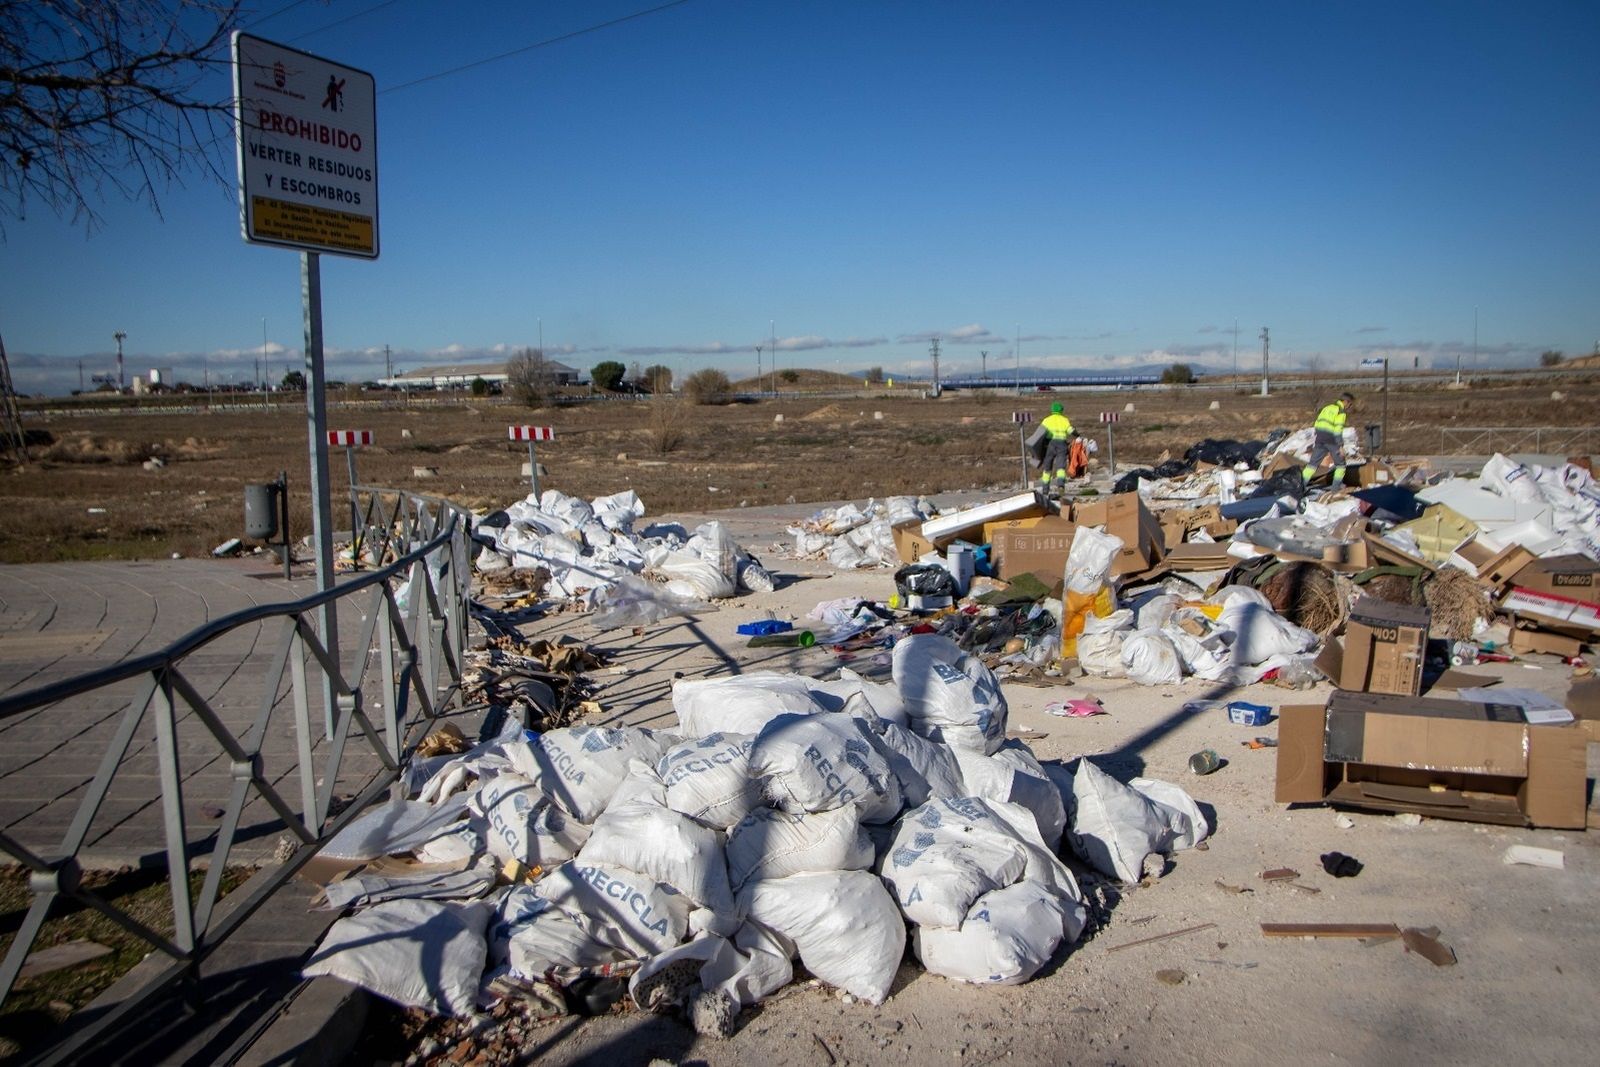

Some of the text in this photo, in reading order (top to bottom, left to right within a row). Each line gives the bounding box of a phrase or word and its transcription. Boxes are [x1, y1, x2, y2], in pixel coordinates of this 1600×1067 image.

[259, 109, 362, 152] PROHIBIDO
[249, 142, 372, 182] VERTER RESIDUOS
[265, 173, 361, 204] Y ESCOMBROS
[580, 866, 669, 937] RECICLA
